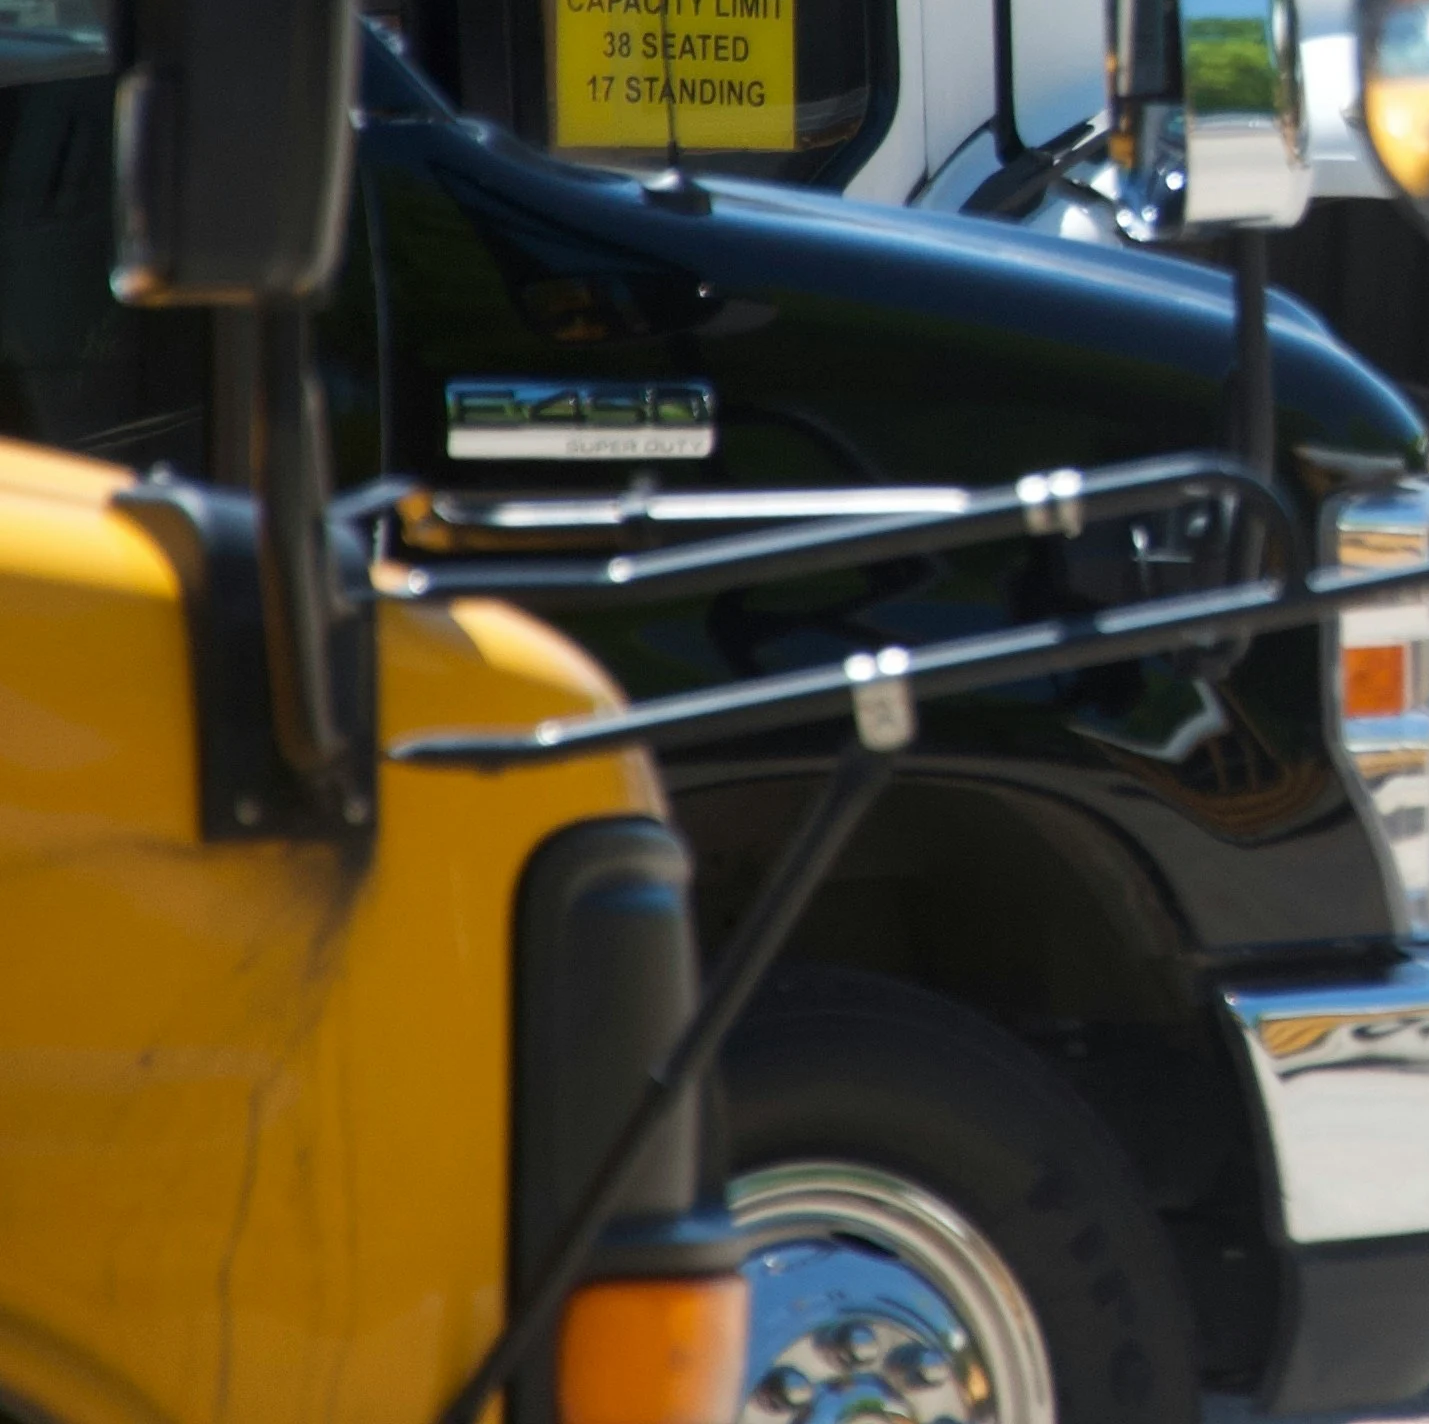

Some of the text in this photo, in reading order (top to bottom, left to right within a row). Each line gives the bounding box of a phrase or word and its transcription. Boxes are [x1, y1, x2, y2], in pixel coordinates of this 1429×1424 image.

[602, 32, 749, 62] 38 SEATED
[587, 76, 766, 107] 17 STANDING
[565, 437, 700, 455] SUPER DUTY
